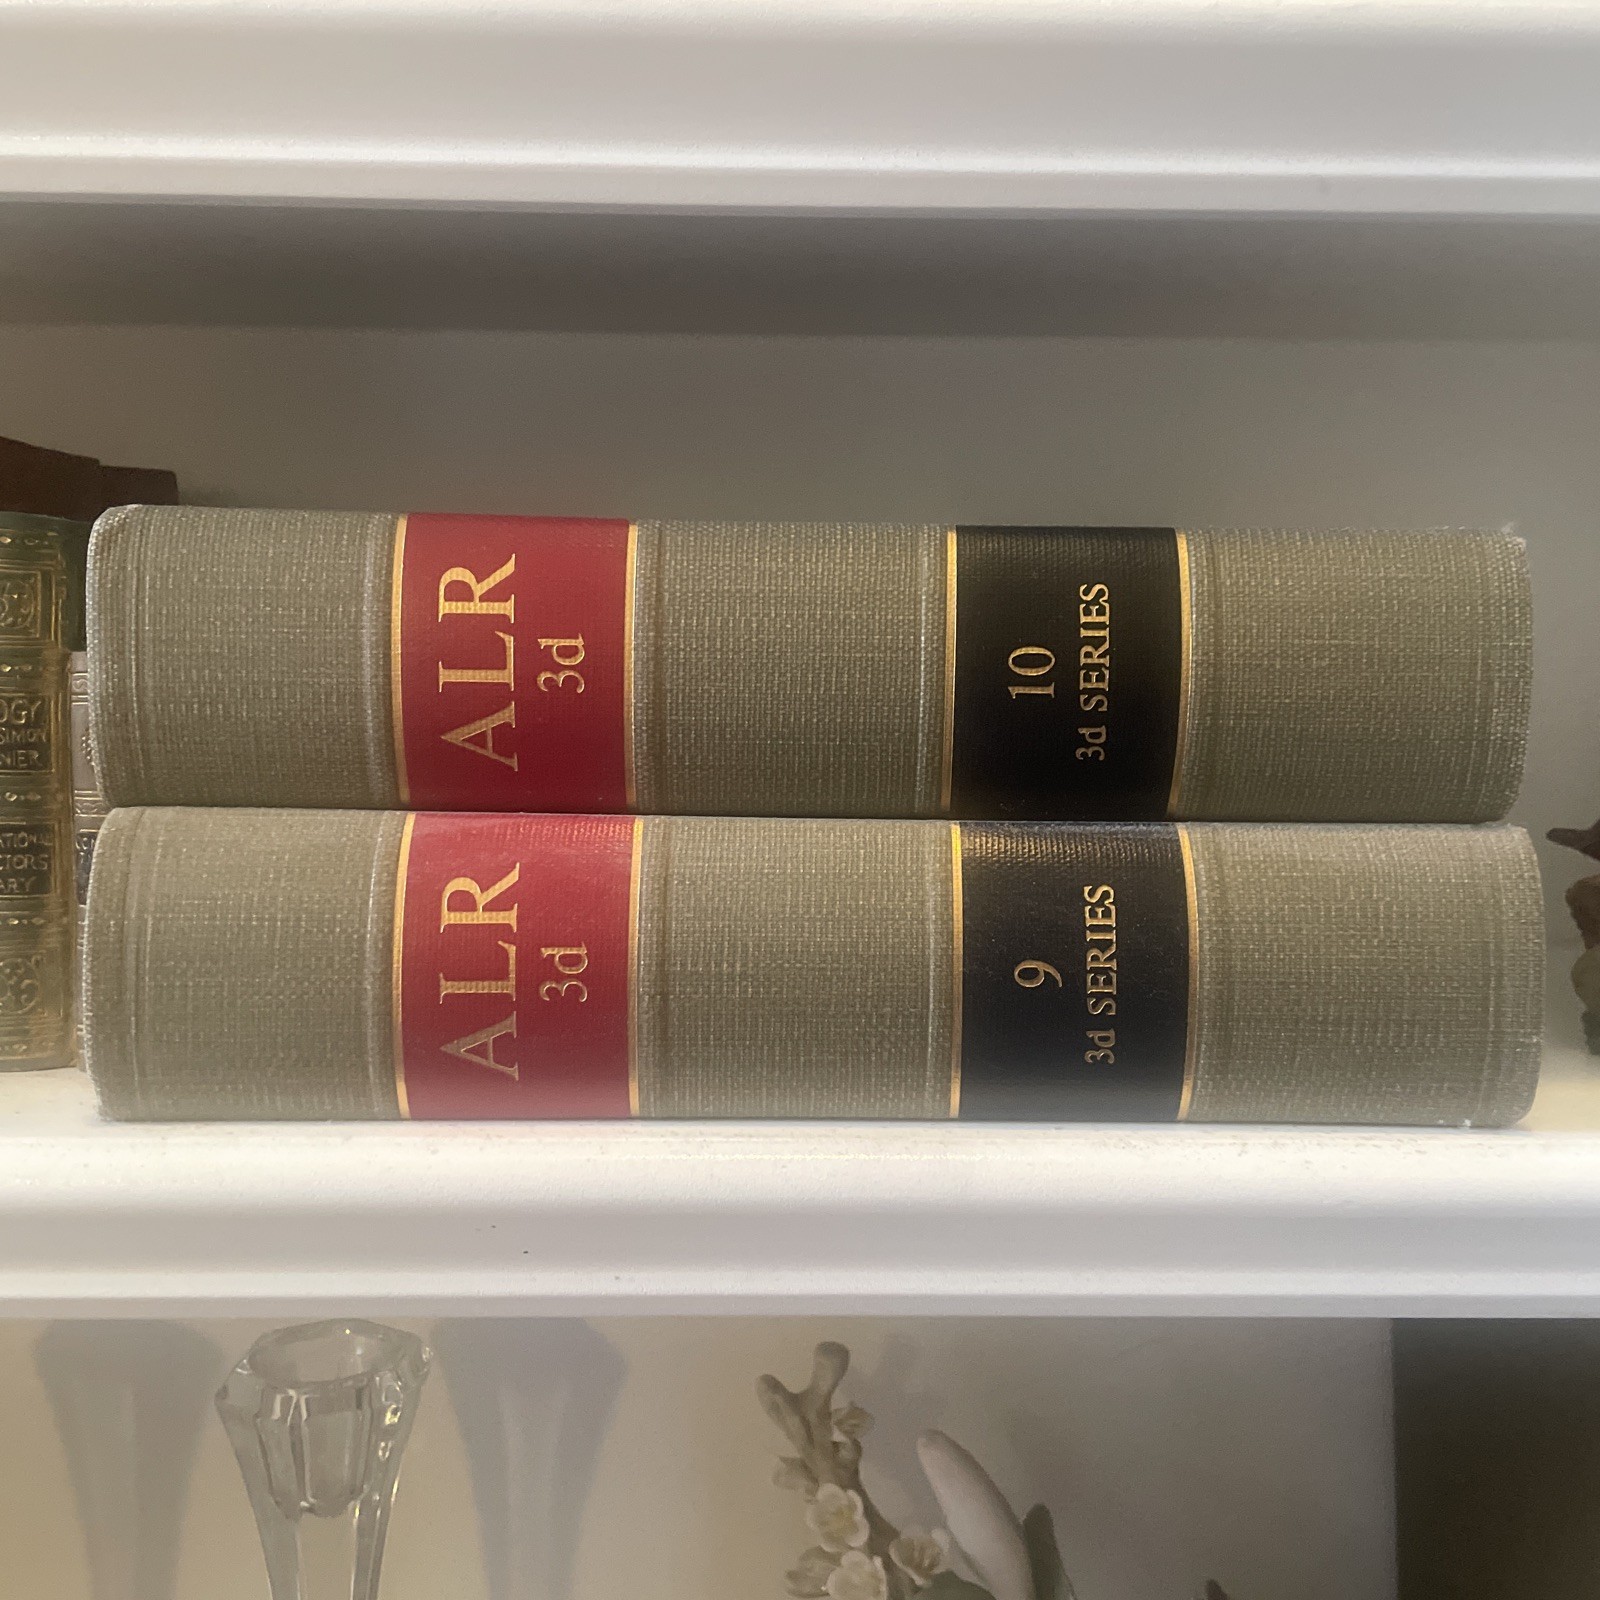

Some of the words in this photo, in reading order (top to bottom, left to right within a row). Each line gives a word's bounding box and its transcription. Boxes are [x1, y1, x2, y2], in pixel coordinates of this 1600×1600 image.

[438, 553, 518, 772] ALR
[537, 633, 585, 693] 3d
[1008, 646, 1055, 699] 10
[1079, 583, 1110, 712] SERIES
[1075, 725, 1107, 761] 3d
[440, 862, 520, 1081] ALR
[540, 942, 588, 1002] 3d
[1014, 959, 1063, 988] 9
[1083, 884, 1117, 1016] SERIES
[1084, 1028, 1116, 1064] 3d
